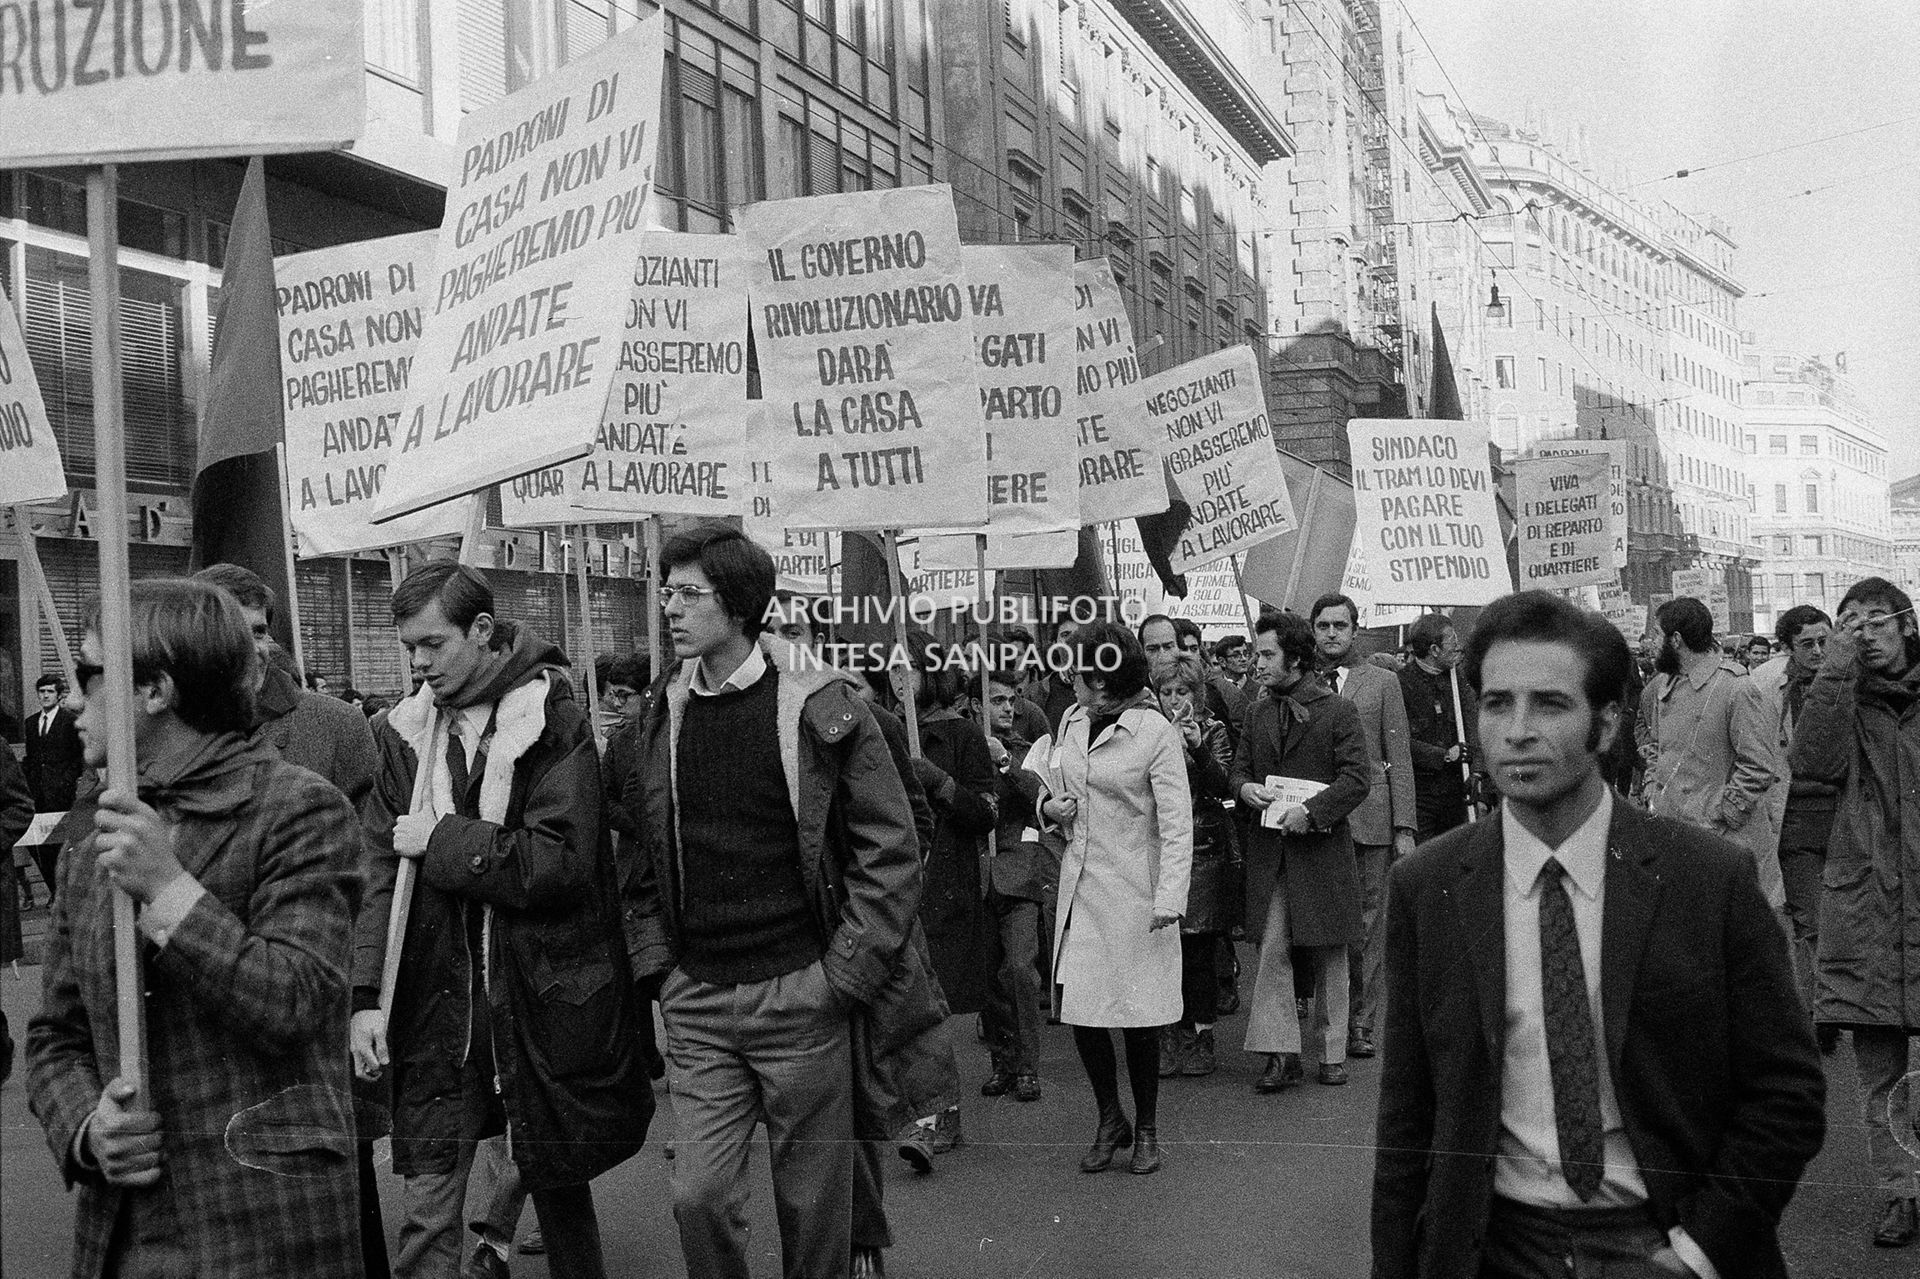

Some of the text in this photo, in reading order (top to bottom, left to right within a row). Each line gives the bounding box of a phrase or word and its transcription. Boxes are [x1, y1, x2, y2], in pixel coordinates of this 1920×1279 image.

[0, 0, 273, 95] RUZIONE
[461, 71, 620, 188] PADRONI DI
[454, 119, 647, 250] CASA NON VI
[434, 164, 652, 316] PAGHEREMO PIÙ
[767, 230, 926, 282] IL GOVERNO
[275, 260, 416, 318] PADRONI DI
[633, 255, 719, 289] OZIANTI
[449, 280, 574, 374] ANDATE
[664, 298, 688, 332] VI
[764, 282, 963, 339] RIVOLUZIONARIO
[286, 306, 423, 365] CASA NON
[975, 332, 1046, 369] GATI
[1076, 317, 1122, 353] N VI
[616, 340, 744, 376] ASSEREMO
[817, 339, 895, 386] DARÀ
[1105, 345, 1139, 389] PIÙ
[286, 355, 414, 411] PAGHEREM
[401, 335, 602, 454] A LAVORARE
[624, 379, 669, 416] PIÙ
[1145, 368, 1237, 417] NEGOZIANTI
[793, 389, 923, 437] LA CASA
[1077, 414, 1111, 447] TE
[1166, 400, 1225, 442] NON VI
[595, 421, 688, 456] ANDATE
[1371, 434, 1458, 462] SINDACO
[582, 459, 600, 492] A
[607, 459, 729, 500] LAVORARE
[816, 452, 841, 492] A
[841, 445, 924, 490] TUTTI
[1202, 461, 1233, 496] PIÙ
[1355, 465, 1486, 492] IL TRAM LO DEVI
[1549, 474, 1580, 492] VIVA
[300, 476, 317, 512] A
[1380, 493, 1464, 521] PAGARE
[1525, 494, 1597, 517] I DELEGATI
[1181, 539, 1197, 561] A
[1197, 499, 1286, 554] LAVORARE
[1380, 523, 1485, 551] CON IL TUO
[1527, 517, 1603, 540] DI REPARTO
[1550, 541, 1575, 558] E DI
[1195, 574, 1239, 588] FIRMER
[1389, 554, 1491, 583] STIPENDIO
[1528, 556, 1601, 580] QUARTIERE
[1168, 605, 1180, 617] IN
[1193, 589, 1221, 601] SOLO
